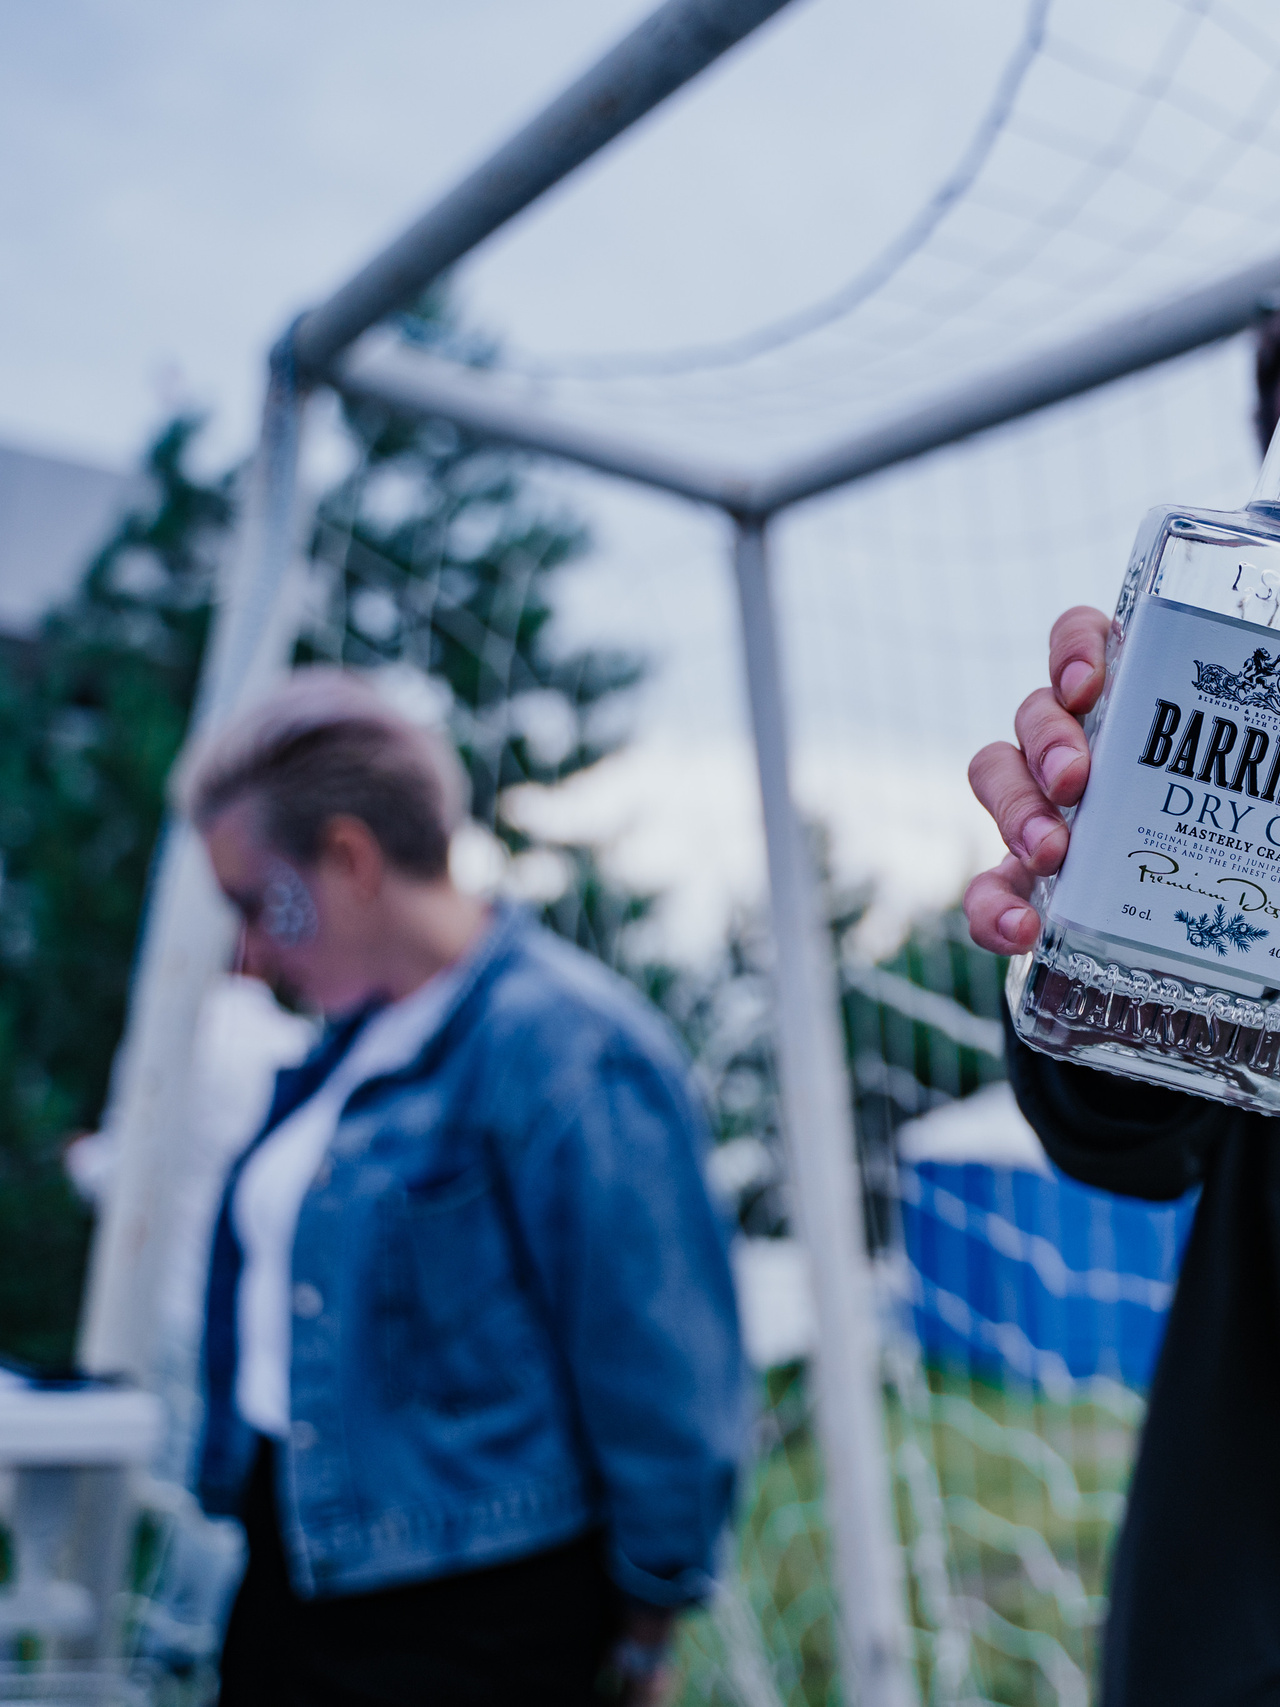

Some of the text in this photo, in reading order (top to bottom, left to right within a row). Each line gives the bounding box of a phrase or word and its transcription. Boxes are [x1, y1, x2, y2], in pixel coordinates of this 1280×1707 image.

[1198, 695, 1240, 712] BLENDED
[1243, 715, 1267, 728] WITH
[1160, 781, 1255, 834] DRY
[1138, 826, 1188, 846] ORIGINAL
[1193, 842, 1225, 857] BLEND
[1229, 853, 1242, 862] OF
[1175, 822, 1254, 853] MASTERLY
[1143, 838, 1177, 853] SPICES
[1182, 849, 1203, 861] AND
[1208, 856, 1227, 868] THE
[1231, 863, 1267, 879] FINEST
[1127, 850, 1230, 902] Premium
[1121, 904, 1152, 922] 50 cl.
